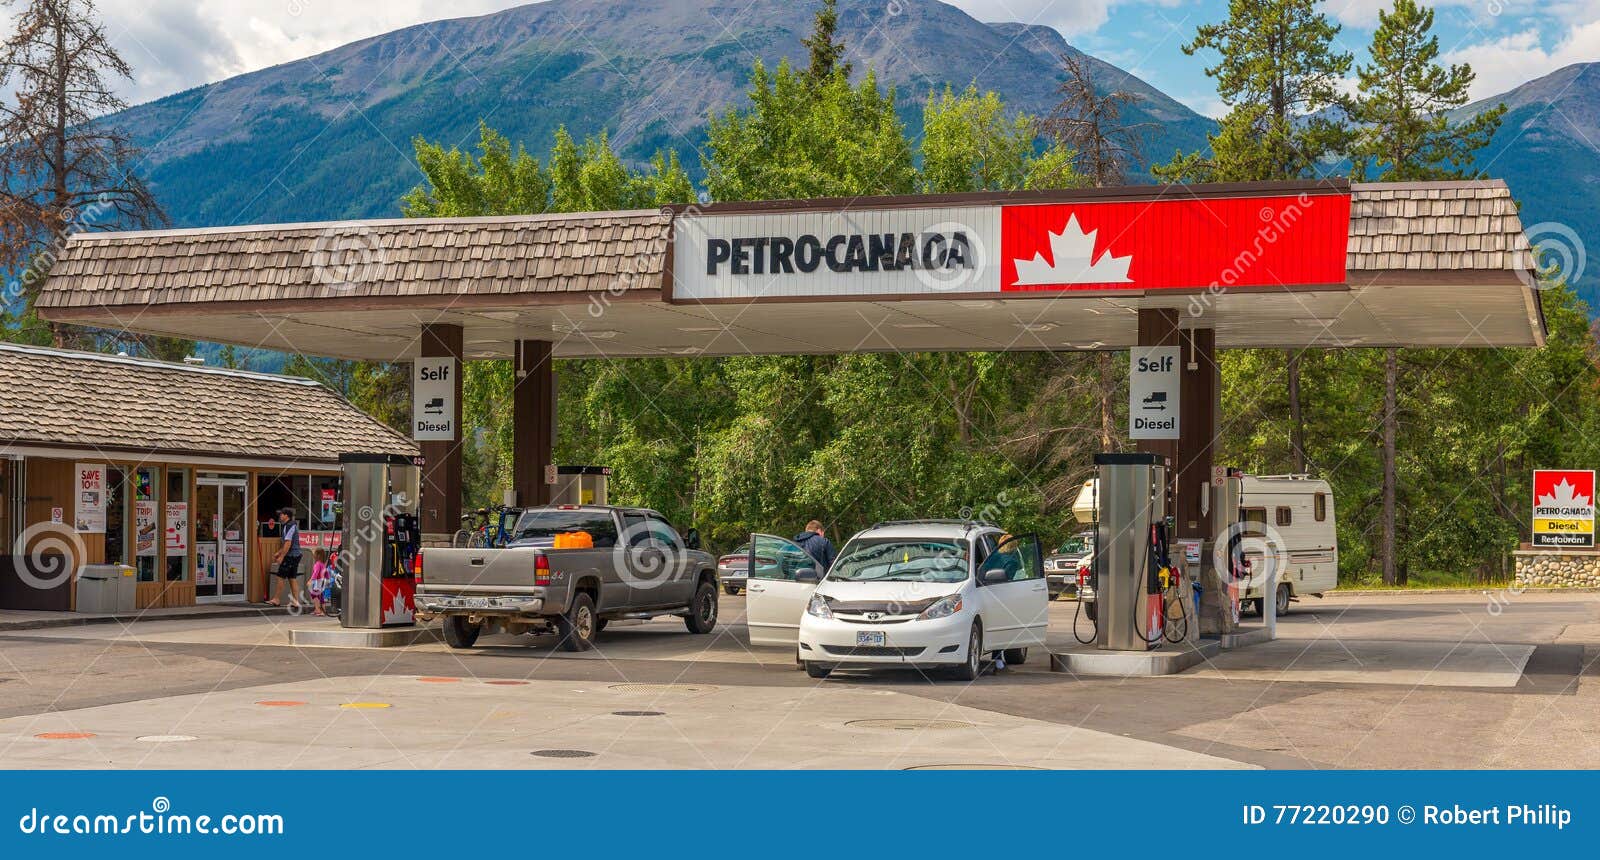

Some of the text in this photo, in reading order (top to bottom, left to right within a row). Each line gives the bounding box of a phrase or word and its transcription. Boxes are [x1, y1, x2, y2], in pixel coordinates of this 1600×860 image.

[707, 231, 975, 276] PETRO-CANADA
[1138, 355, 1173, 372] Self
[421, 366, 449, 381] Self
[417, 420, 450, 432] Diesel
[1134, 417, 1175, 430] Diesel
[81, 470, 100, 481] SAVE
[1548, 521, 1579, 530] Diesel
[1541, 535, 1585, 544] Restaurant
